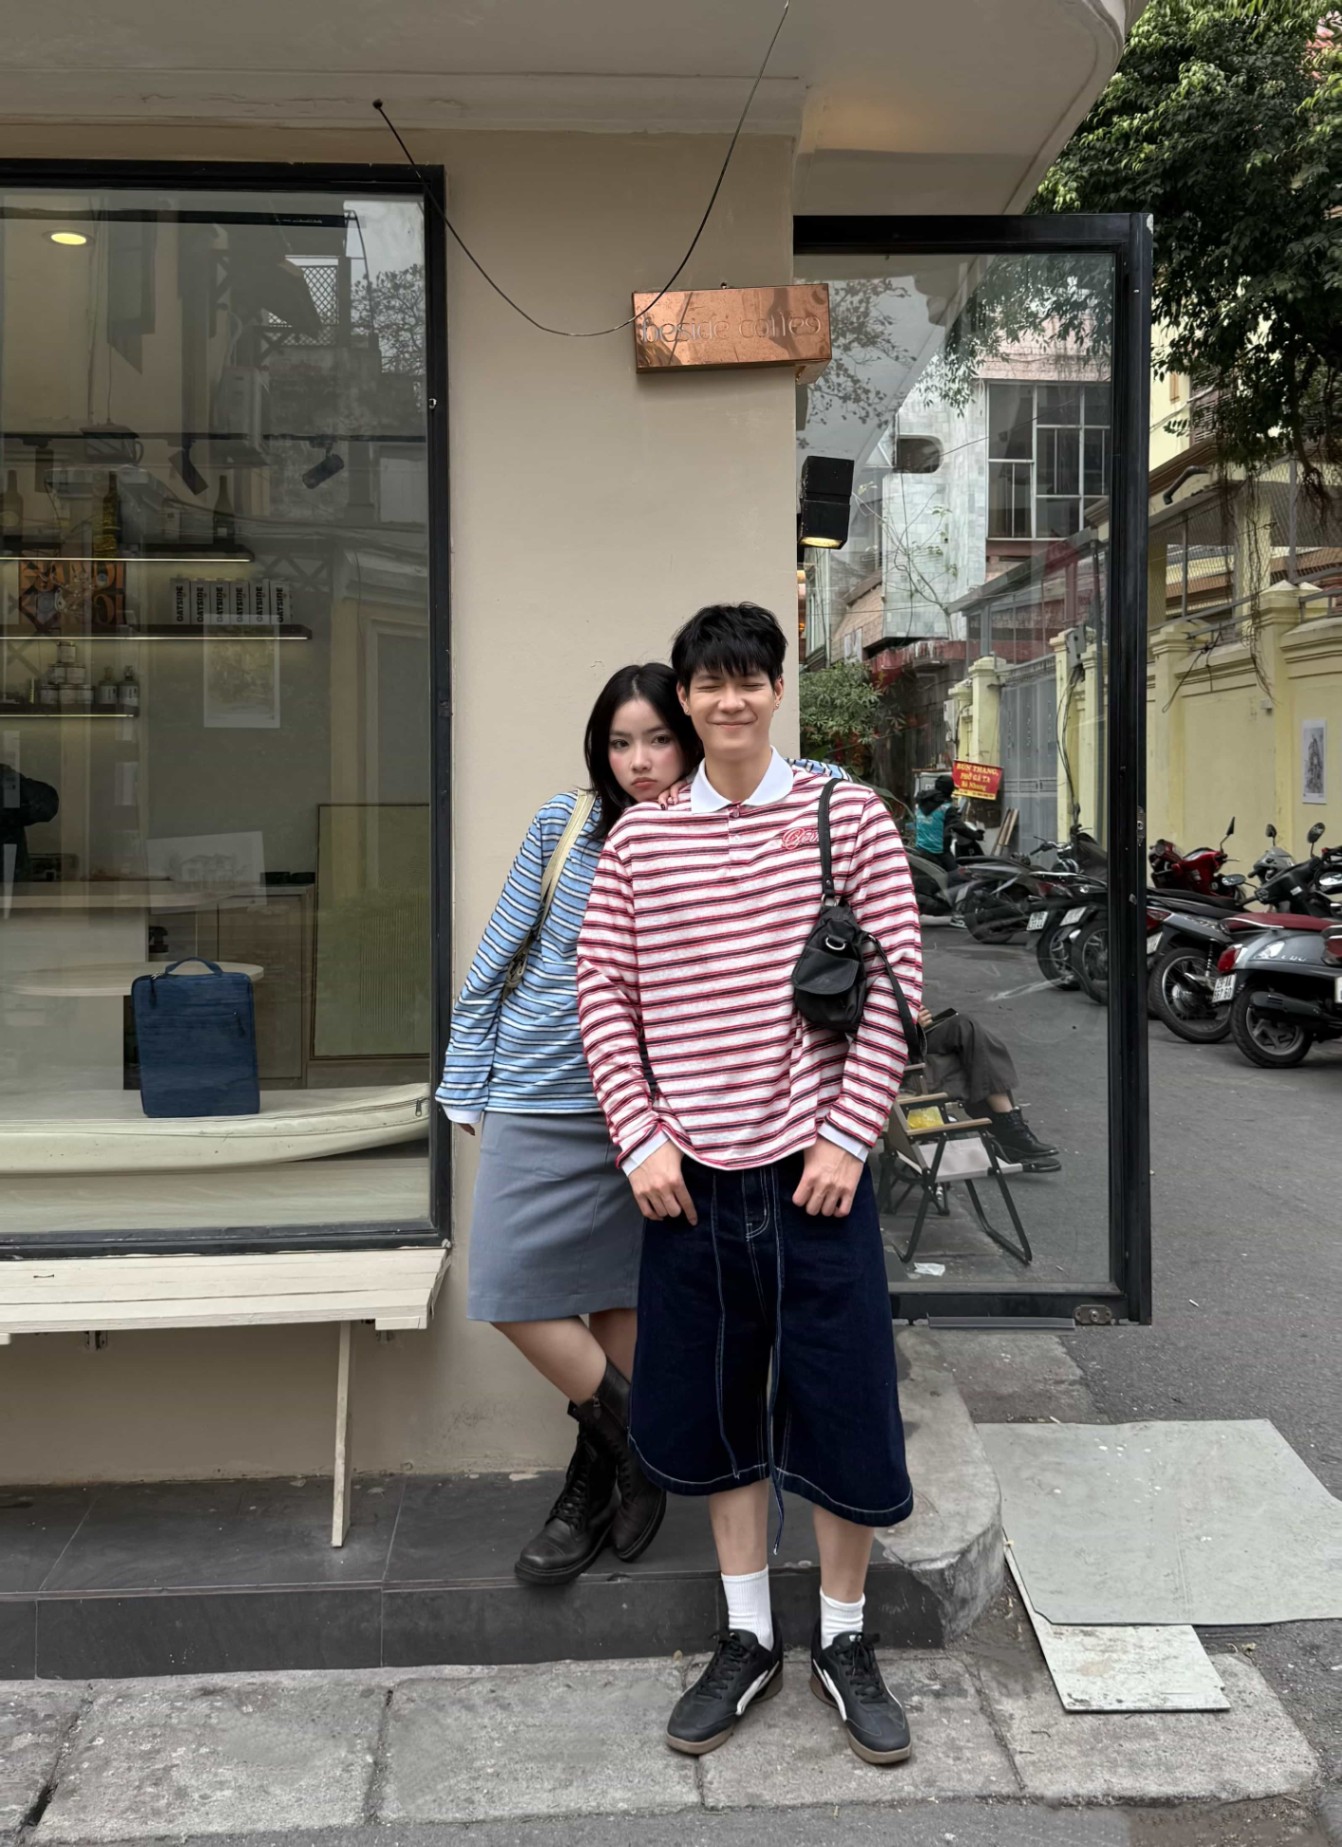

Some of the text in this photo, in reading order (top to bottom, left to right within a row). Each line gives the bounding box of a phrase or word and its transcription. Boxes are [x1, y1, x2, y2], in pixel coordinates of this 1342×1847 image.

[641, 314, 730, 343] beside
[176, 586, 184, 622] OATSIDE
[196, 587, 205, 623] OATSIDE
[215, 587, 224, 622] OATSIDE
[235, 587, 243, 622] OATSIDE
[256, 586, 264, 622] OATSIDE
[276, 587, 284, 623] OATSIDE
